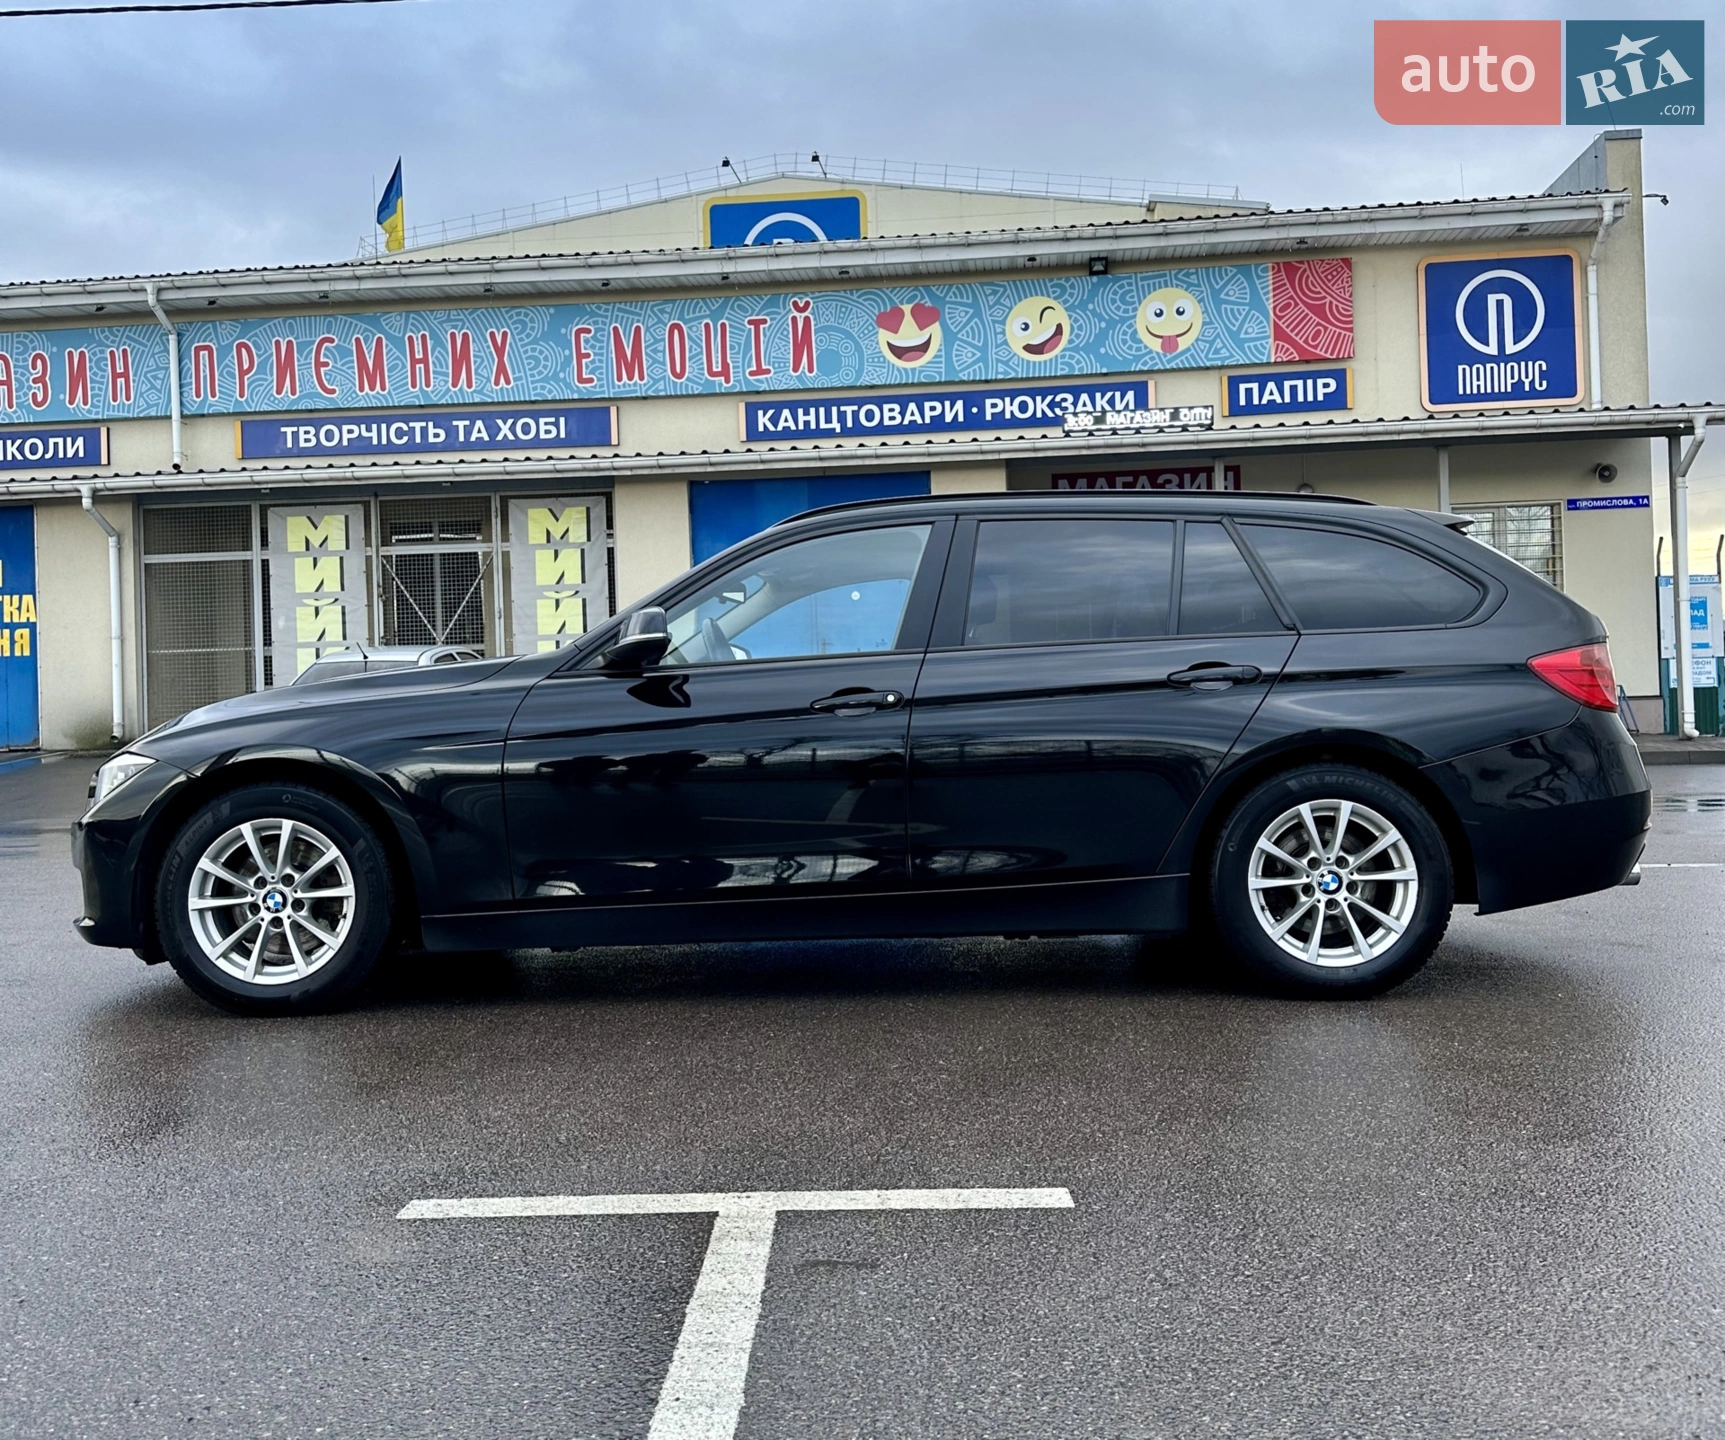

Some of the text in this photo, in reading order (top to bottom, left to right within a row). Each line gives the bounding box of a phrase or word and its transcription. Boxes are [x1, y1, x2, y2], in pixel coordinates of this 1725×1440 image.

[192, 328, 514, 401] ПРИЄМНИХ
[572, 298, 816, 387] ЕМОЦІЙ
[1238, 377, 1337, 406] ПАПІР
[1458, 361, 1547, 395] ПАПІРУС
[757, 391, 1135, 433] КАНЦТОВАРИ РЮКЗАКИ
[1106, 410, 1174, 425] МАГАЗИН
[281, 417, 566, 448] ТВОРЧІСТЬ ТА ХОБІ
[0, 436, 85, 461] КОЛИ
[1577, 499, 1637, 508] ПРОМИСЛОВА,
[527, 506, 591, 653] МИЙ
[0, 594, 37, 623] КА
[1323, 775, 1397, 801] MICHELIN
